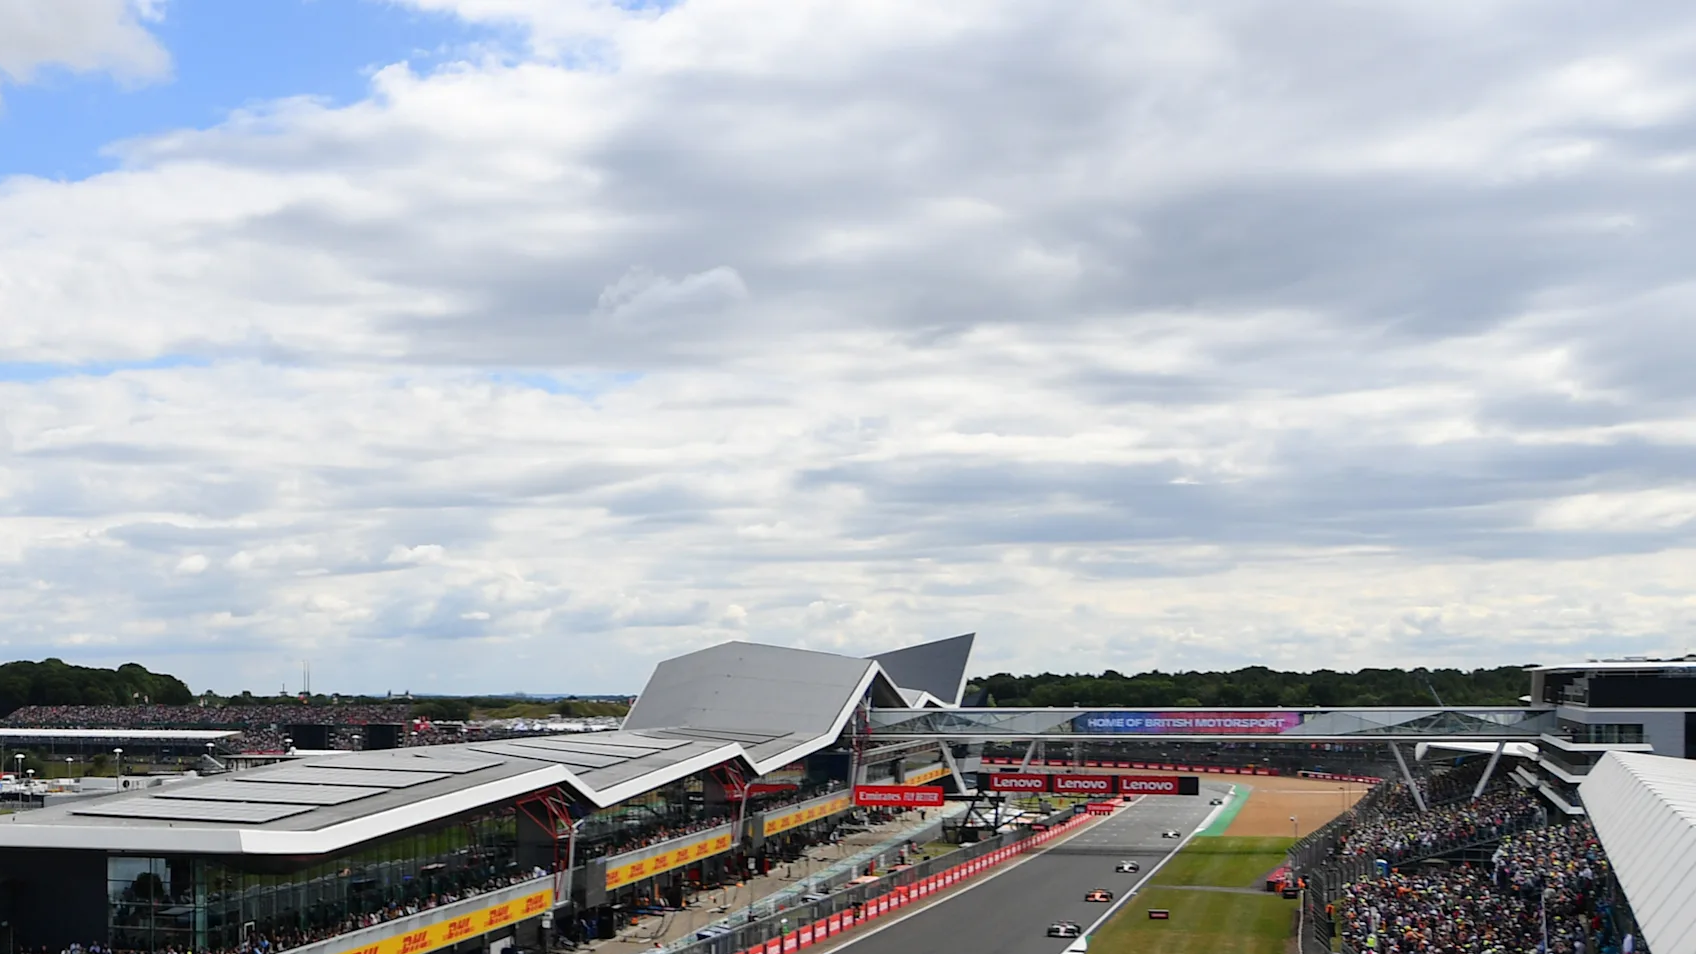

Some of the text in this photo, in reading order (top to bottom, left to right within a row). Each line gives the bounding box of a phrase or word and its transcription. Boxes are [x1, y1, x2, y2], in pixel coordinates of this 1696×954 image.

[1087, 718, 1285, 728] HOME OF BRITISH MOTORSPORT
[993, 777, 1043, 788] Lenovo
[1057, 778, 1107, 789] Lenovo
[1122, 779, 1174, 791] Lenovo
